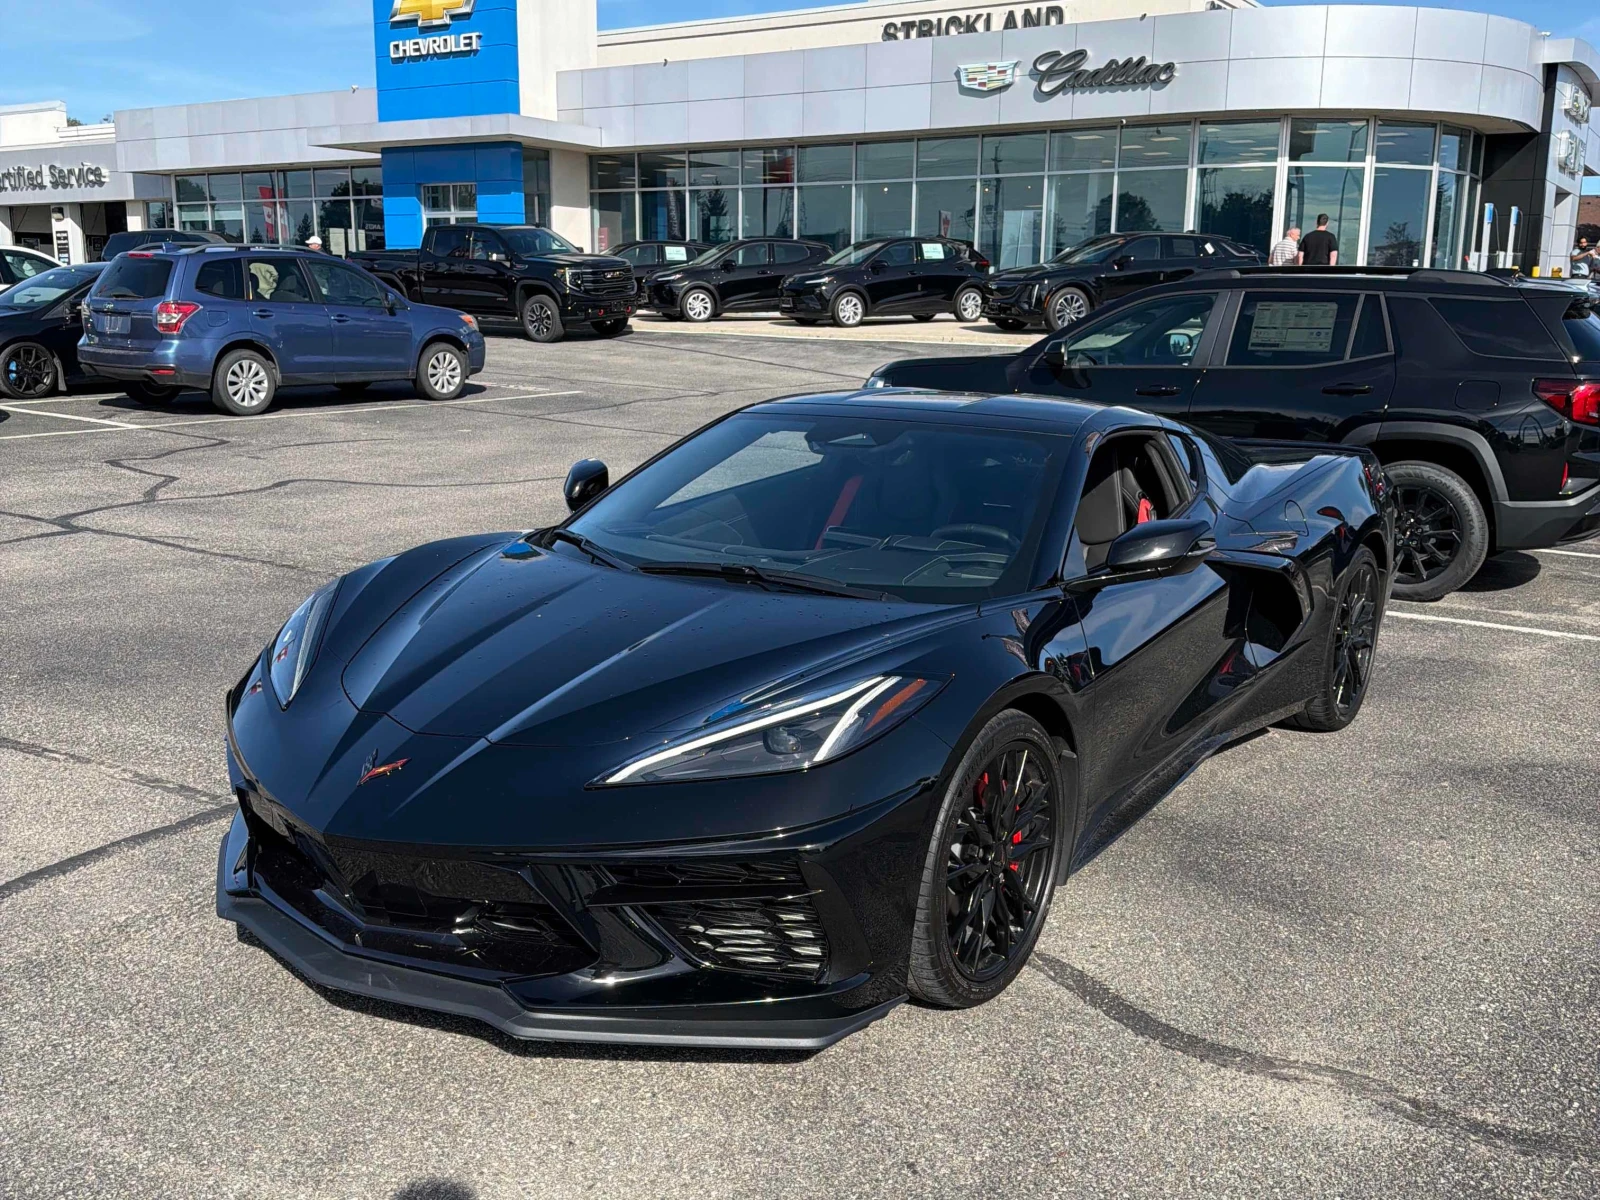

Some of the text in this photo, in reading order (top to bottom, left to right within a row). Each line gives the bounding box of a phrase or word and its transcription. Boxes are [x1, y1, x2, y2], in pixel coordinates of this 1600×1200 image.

[882, 5, 1065, 42] STRICKLAND
[389, 32, 482, 59] CHEVROLET
[1032, 49, 1177, 96] Cadillac
[0, 161, 106, 190] rtified Service
